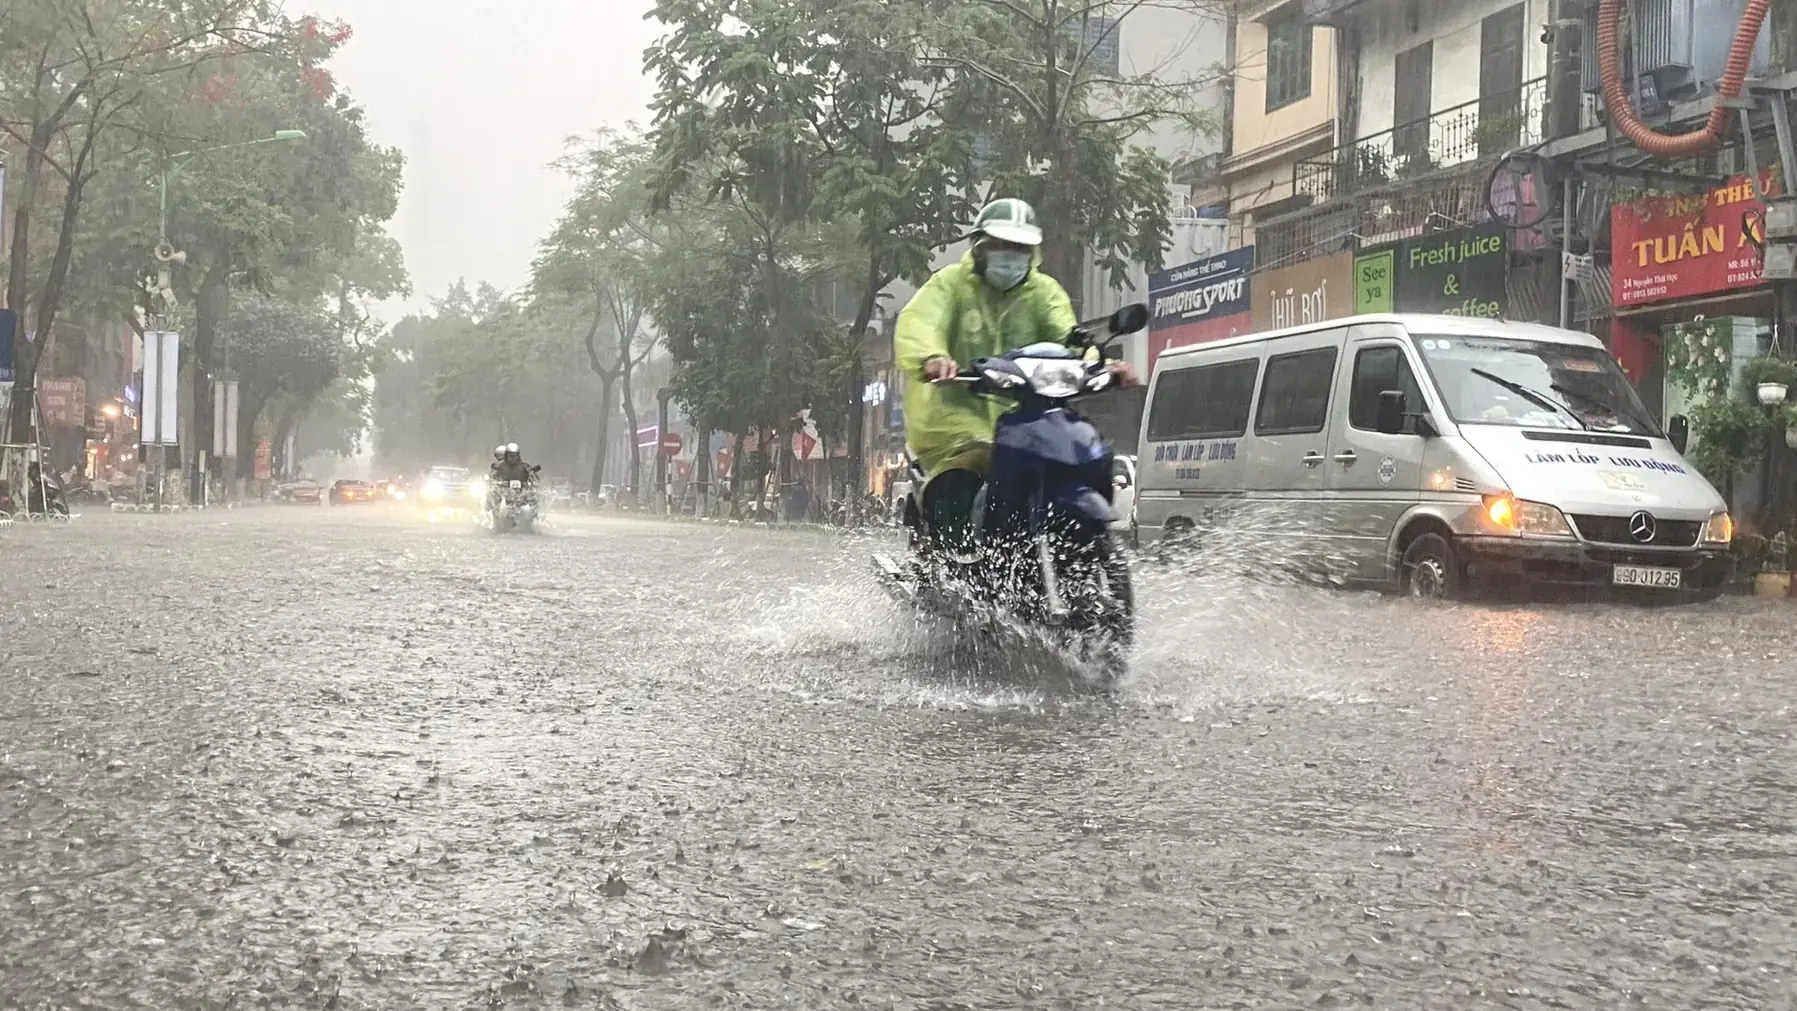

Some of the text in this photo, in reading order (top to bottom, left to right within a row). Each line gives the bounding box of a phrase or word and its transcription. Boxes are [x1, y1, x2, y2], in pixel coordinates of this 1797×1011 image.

[1410, 236, 1500, 269] Fresh juice
[1632, 219, 1724, 267] TUẤN
[1362, 267, 1386, 282] See
[1444, 274, 1458, 295] &
[1623, 278, 1632, 289] 34
[1366, 288, 1381, 303] ya
[1567, 448, 1600, 464] LỐP
[1608, 456, 1642, 468] LƯU
[1642, 459, 1687, 475] ĐỘNG
